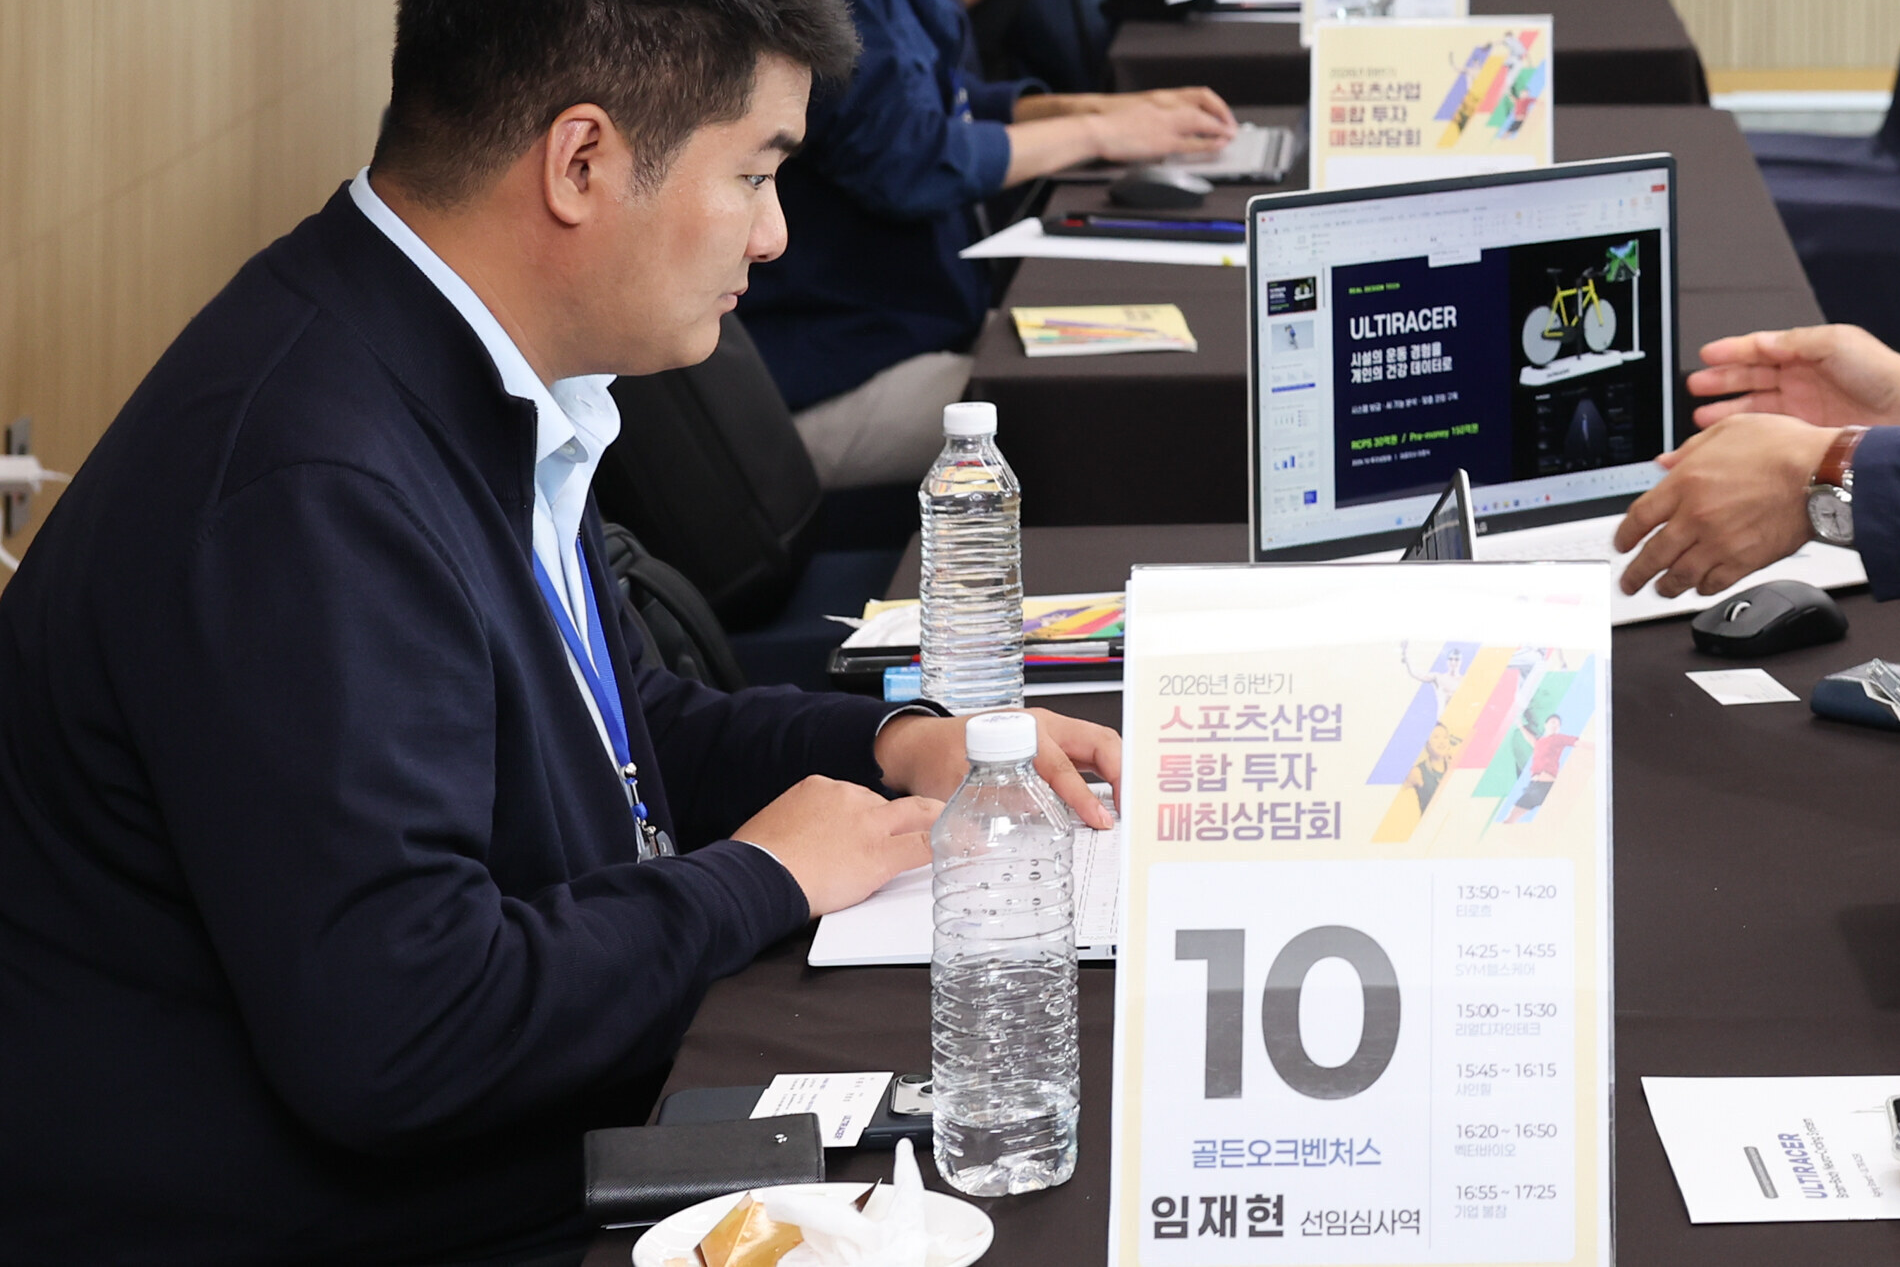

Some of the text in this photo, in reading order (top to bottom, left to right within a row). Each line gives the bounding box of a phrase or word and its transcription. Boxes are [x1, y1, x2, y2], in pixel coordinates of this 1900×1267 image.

[1350, 305, 1457, 340] ULTIRACER
[1158, 673, 1293, 696] 2026년 하반기
[1158, 703, 1342, 743] 스포츠산업
[1157, 752, 1317, 793] 통합 투자
[1157, 801, 1341, 842] 매칭상담회
[1174, 925, 1402, 1101] 10
[1191, 1137, 1382, 1169] 골든오크벤처스
[1777, 1133, 1828, 1199] ULTIRACER
[1151, 1194, 1421, 1240] 임재현 선임심사역
